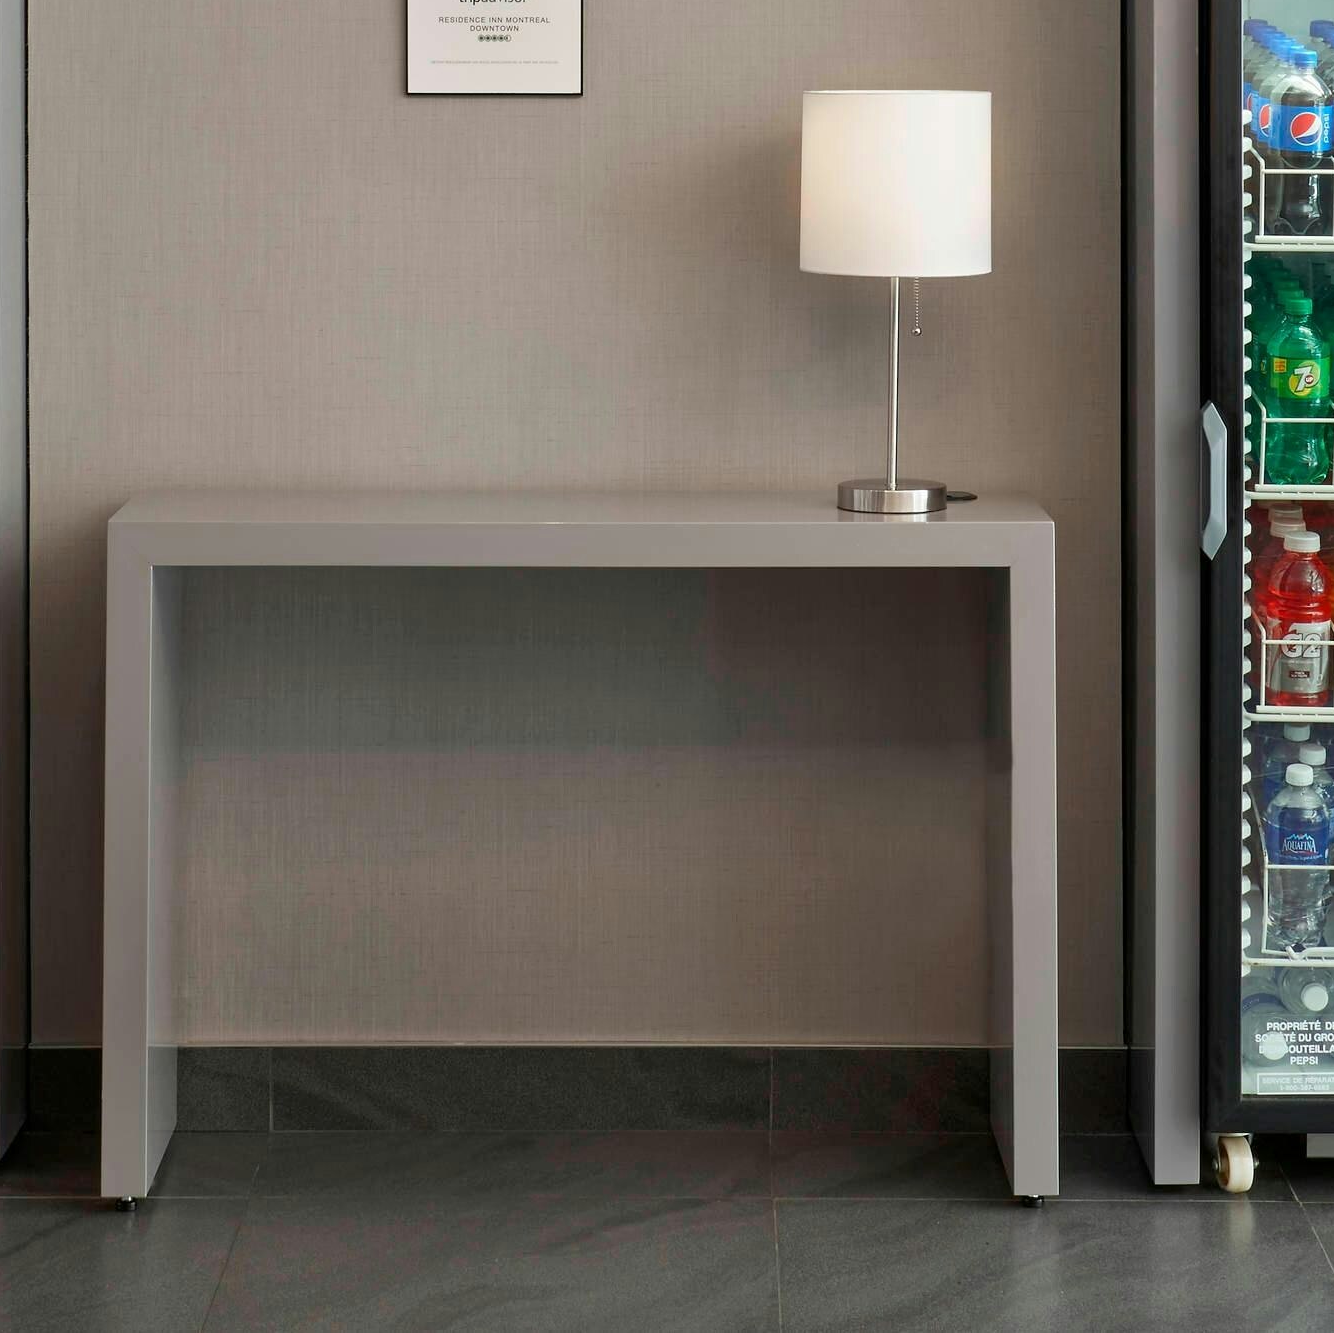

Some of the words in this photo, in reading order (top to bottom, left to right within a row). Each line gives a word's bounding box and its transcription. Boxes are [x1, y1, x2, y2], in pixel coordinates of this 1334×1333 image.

[1322, 113, 1330, 144] pepsi
[1281, 633, 1322, 659] G2
[1266, 1020, 1321, 1031] PROPRIÉTÉ
[1298, 1033, 1312, 1042] DU
[1290, 1056, 1319, 1065] PEPSI
